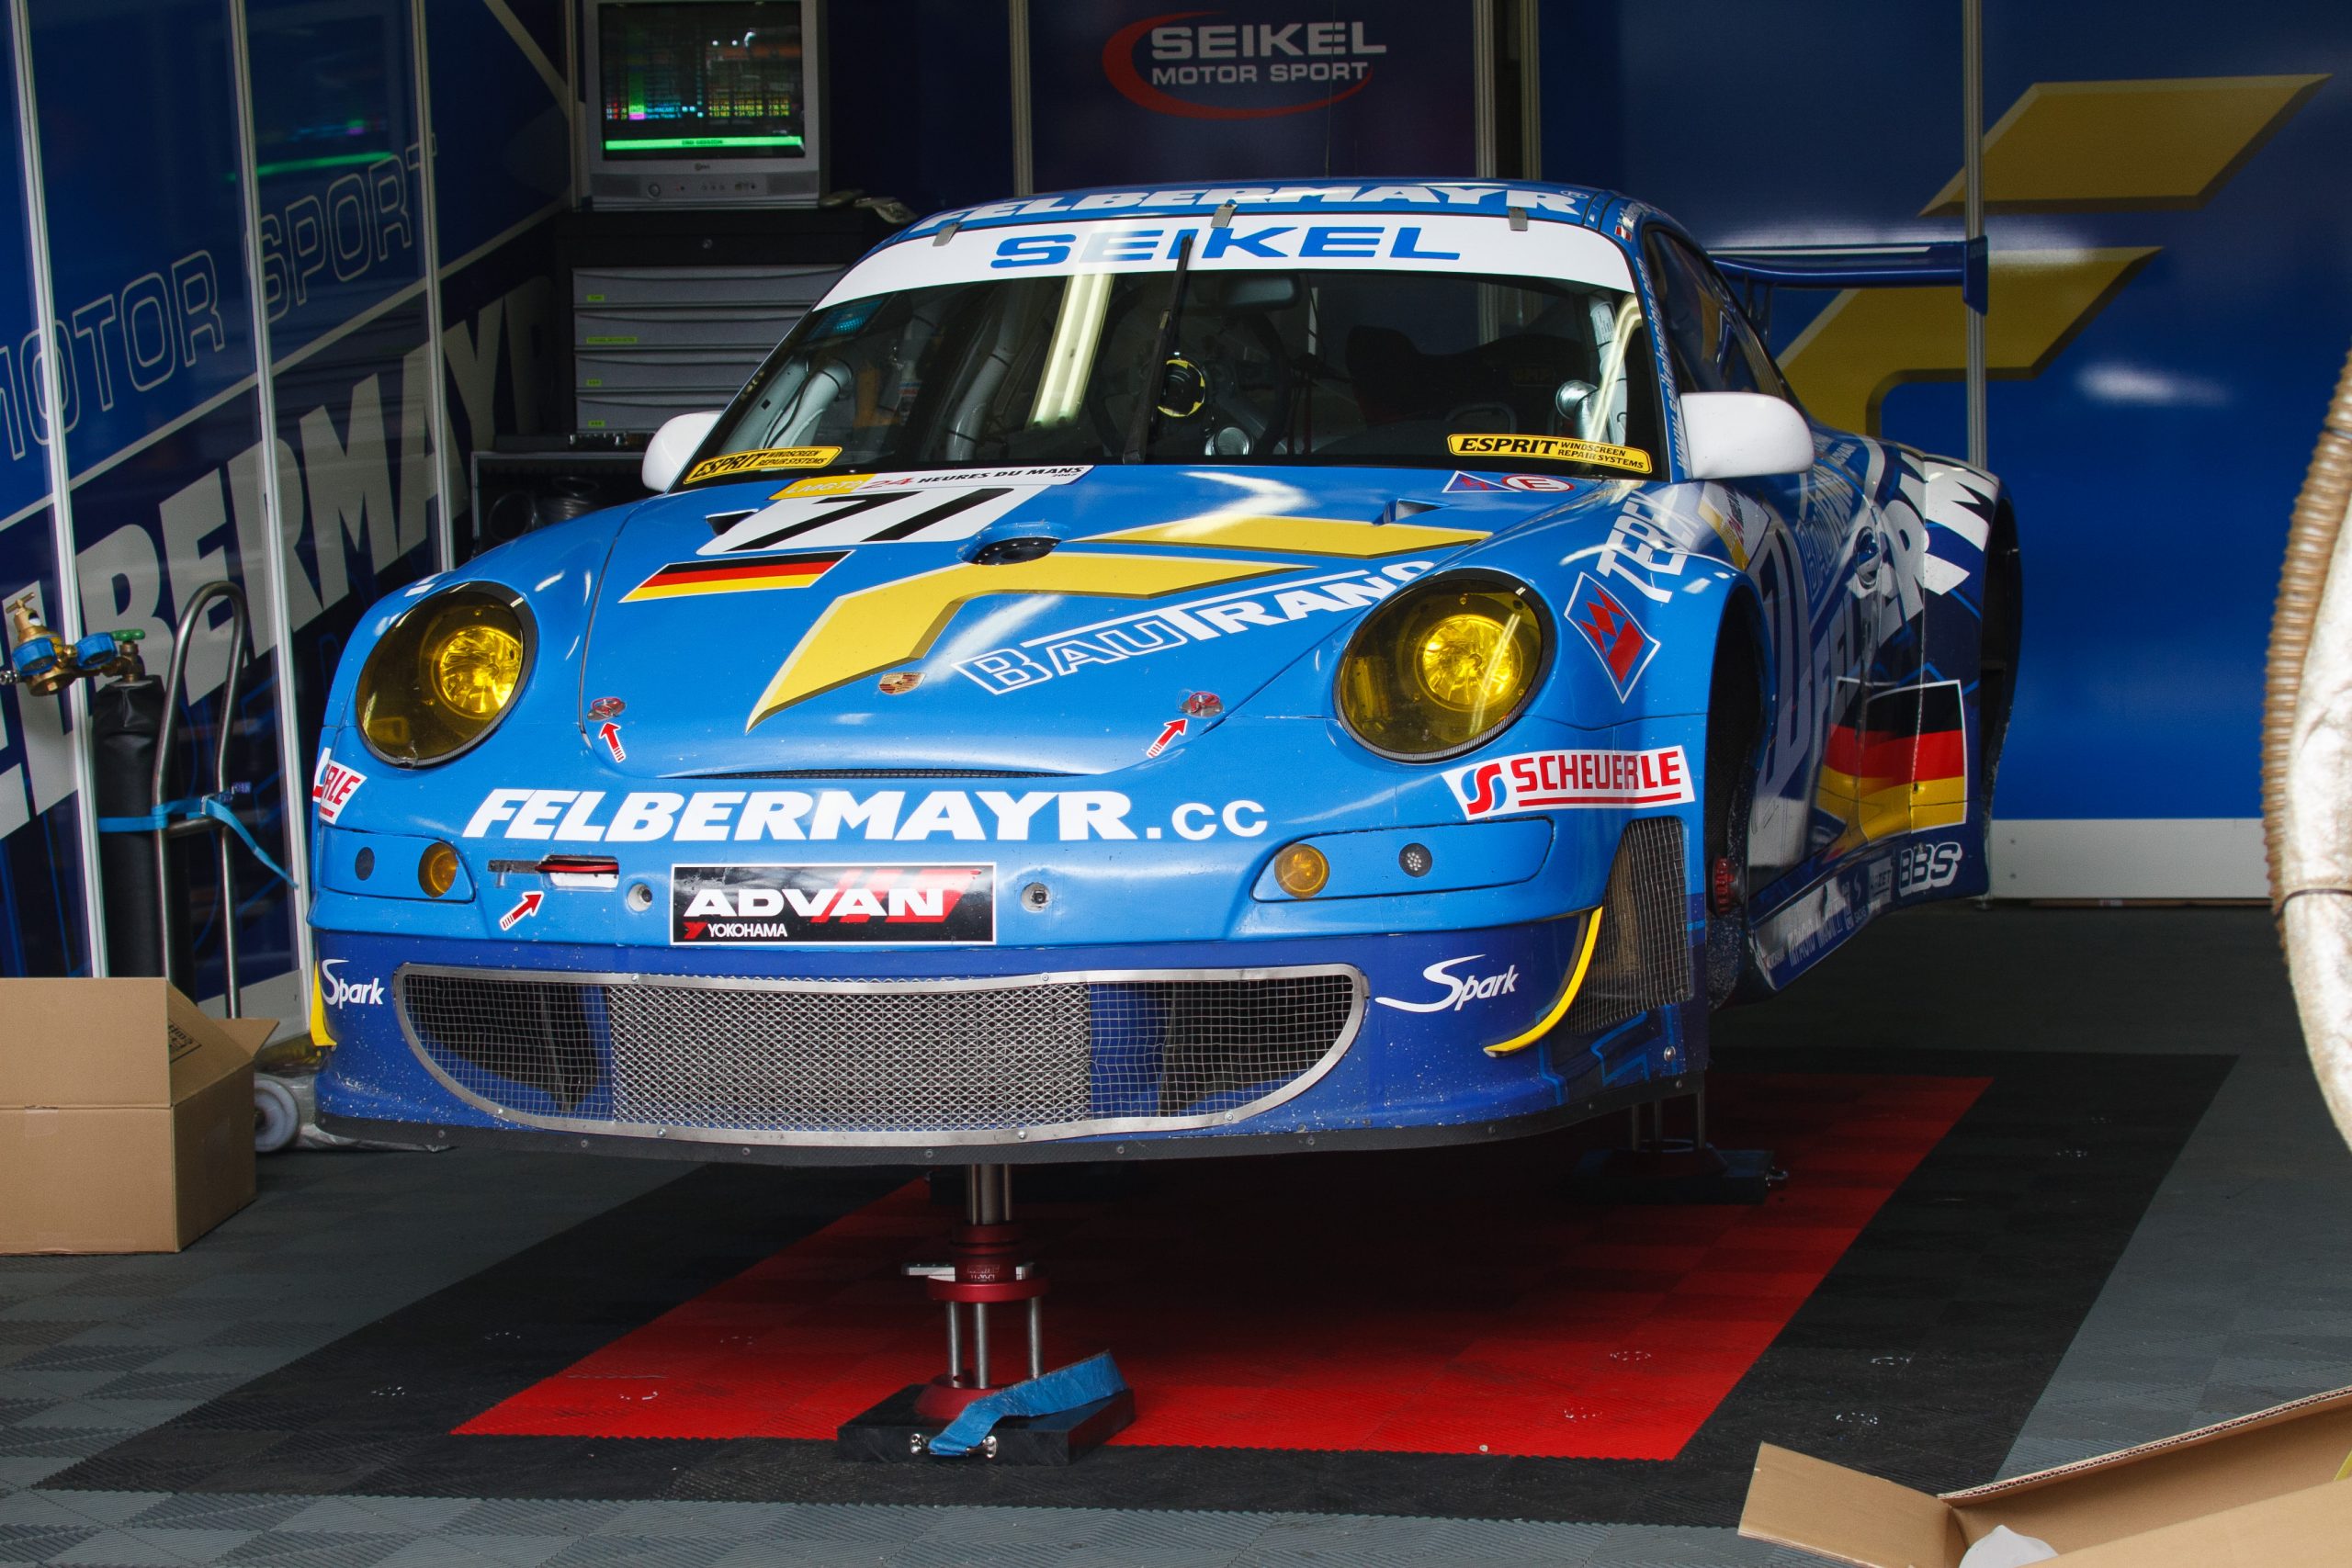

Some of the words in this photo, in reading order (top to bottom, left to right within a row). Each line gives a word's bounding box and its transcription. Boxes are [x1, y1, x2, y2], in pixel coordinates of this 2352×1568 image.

[1151, 21, 1387, 60] SEIKEL
[1151, 63, 1257, 85] MOTOR
[1270, 62, 1369, 82] SPORT
[910, 186, 1582, 232] FELBERMAYR
[990, 227, 1460, 268] SEIKEL
[766, 450, 822, 458] WINDSCREEN
[1460, 438, 1558, 455] ESPRIT
[1557, 448, 1597, 460] REPAIR
[1597, 454, 1645, 469] SYSTEMS
[1560, 441, 1626, 457] WINDSCREEN
[691, 453, 768, 479] ESPRIT
[785, 457, 827, 466] SYSTEMS
[919, 472, 991, 484] HEURES
[992, 469, 1023, 478] DU
[1024, 467, 1085, 476] MANS
[1515, 746, 1682, 792] SCHEUERLE
[324, 763, 361, 806] RLE
[1899, 841, 1962, 897] BBS
[683, 887, 946, 918] ADVAN
[707, 921, 788, 938] YOKOHAMA
[322, 959, 385, 1010] Spark
[1374, 954, 1520, 1013] Spark
